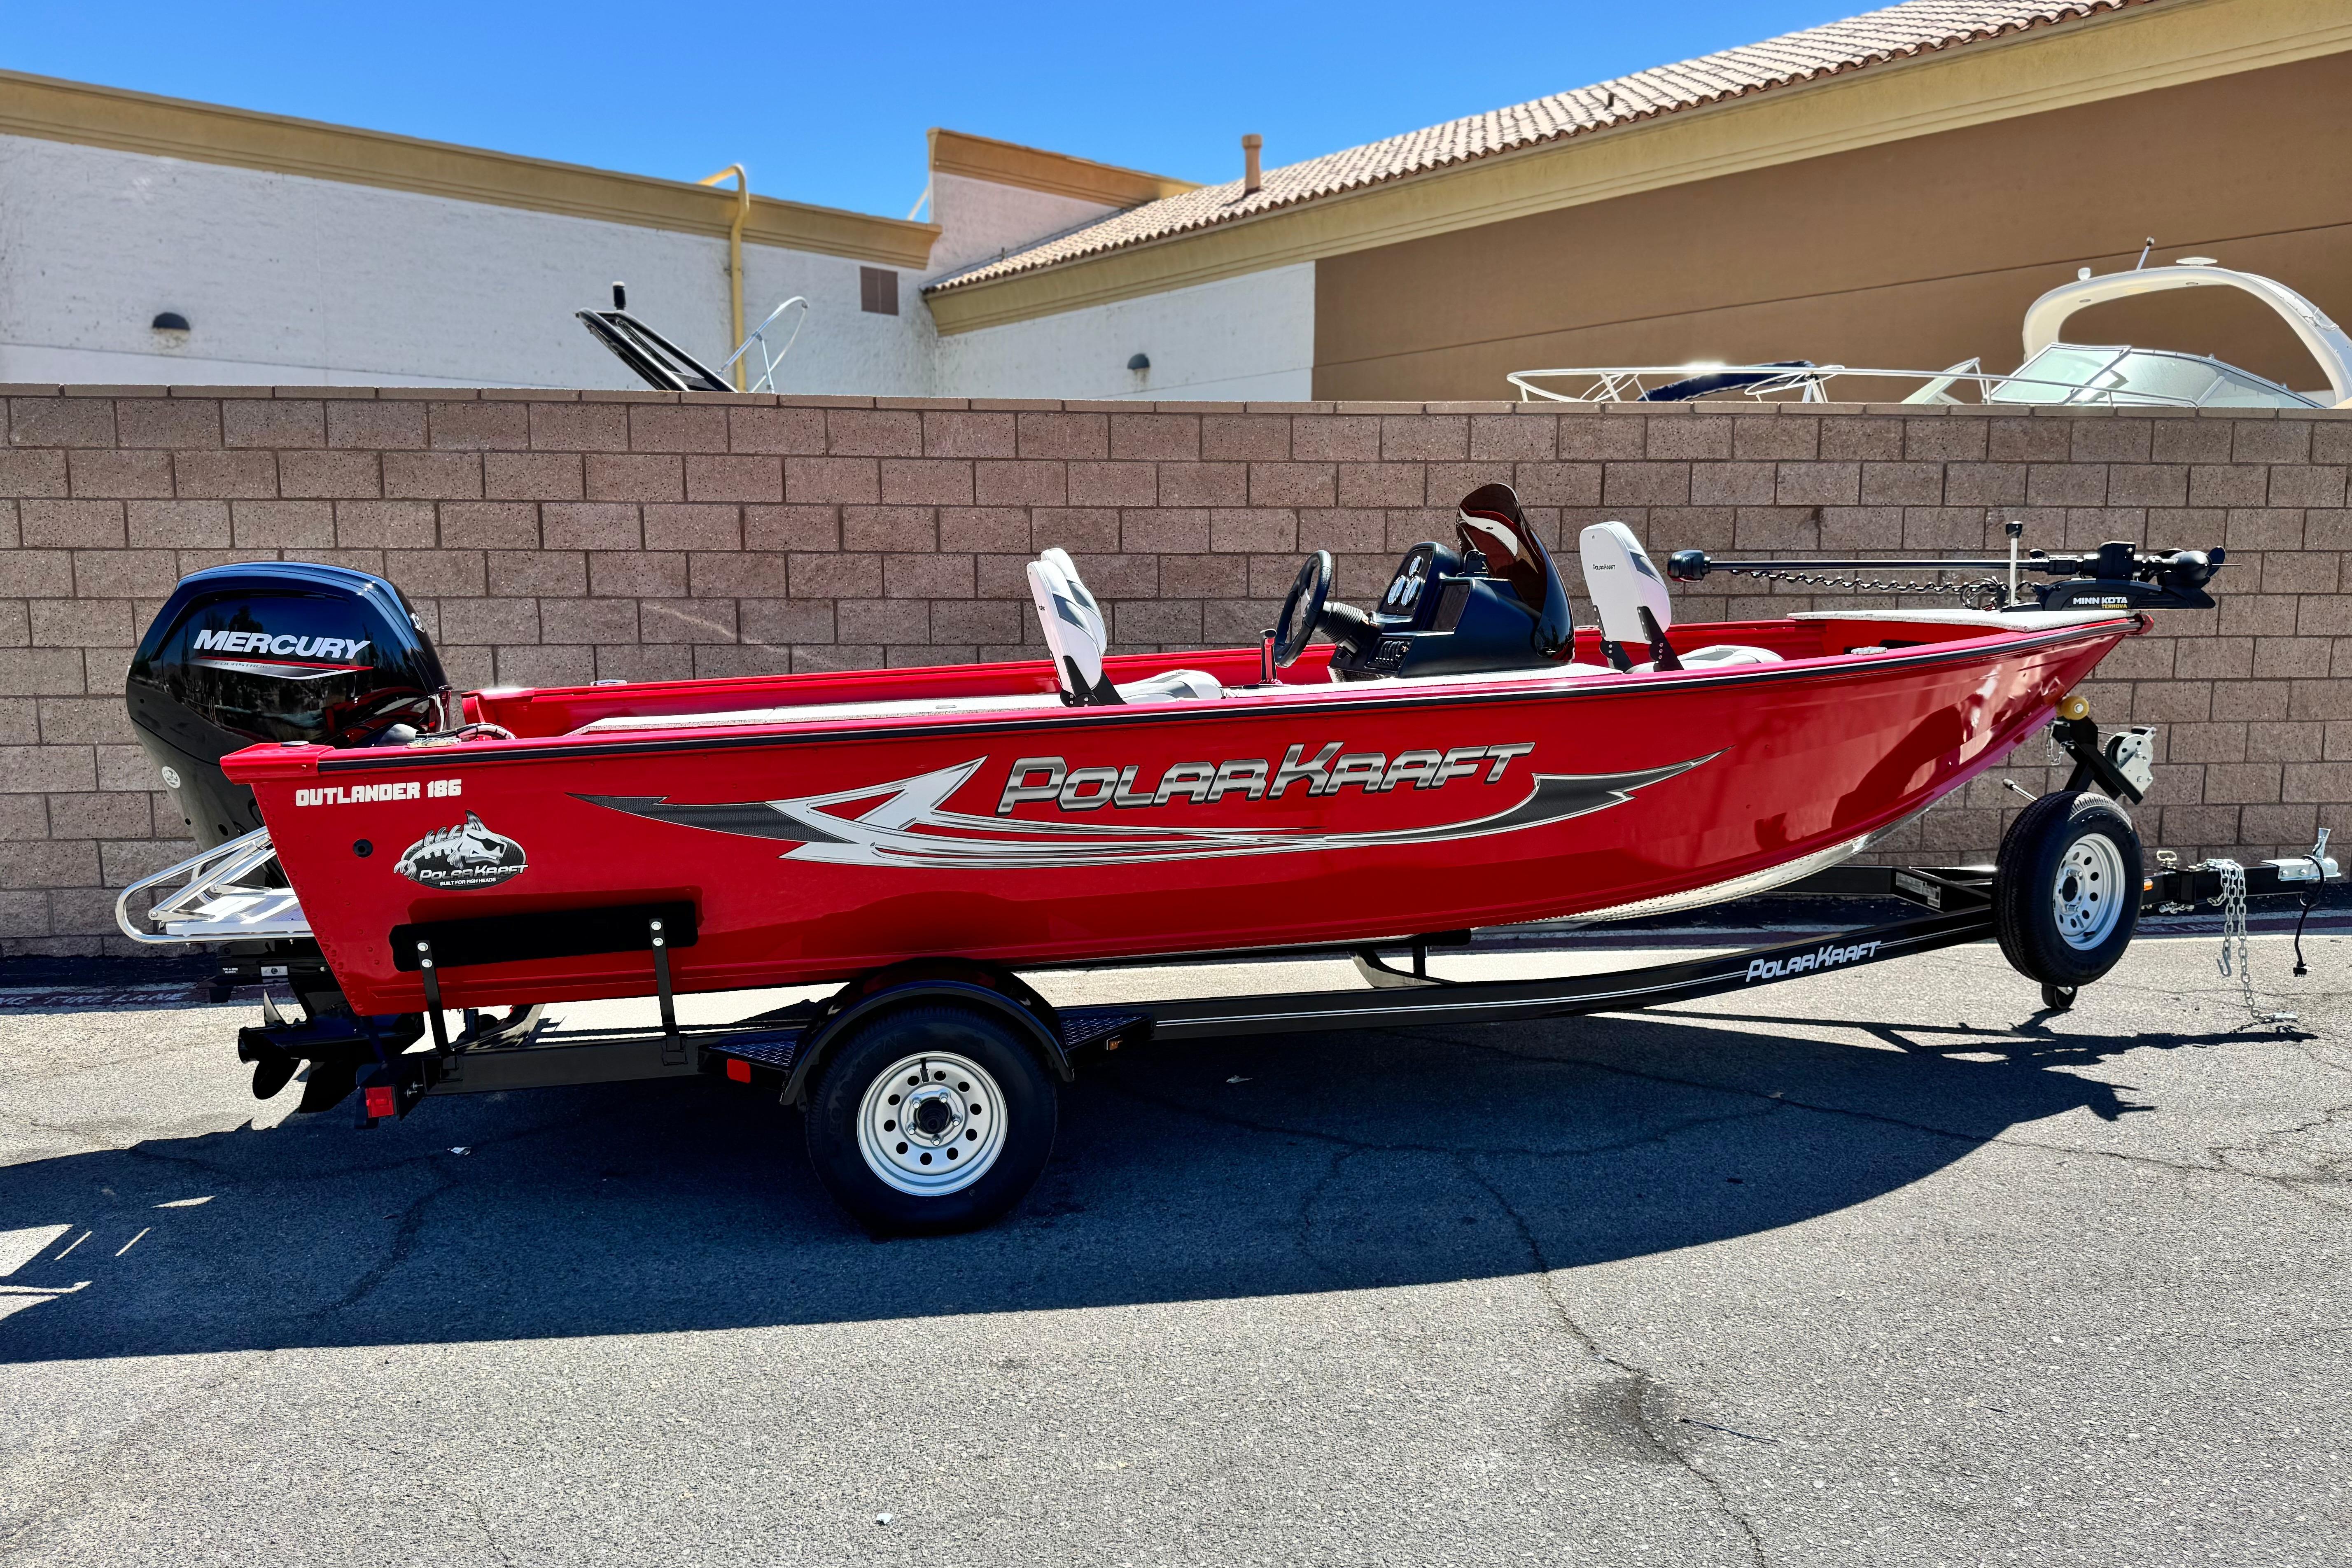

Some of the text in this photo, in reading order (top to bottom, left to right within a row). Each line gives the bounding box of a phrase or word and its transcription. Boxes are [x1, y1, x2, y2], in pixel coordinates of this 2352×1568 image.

[194, 629, 371, 660] MERCURY
[295, 779, 462, 807] OUTLANDER 186
